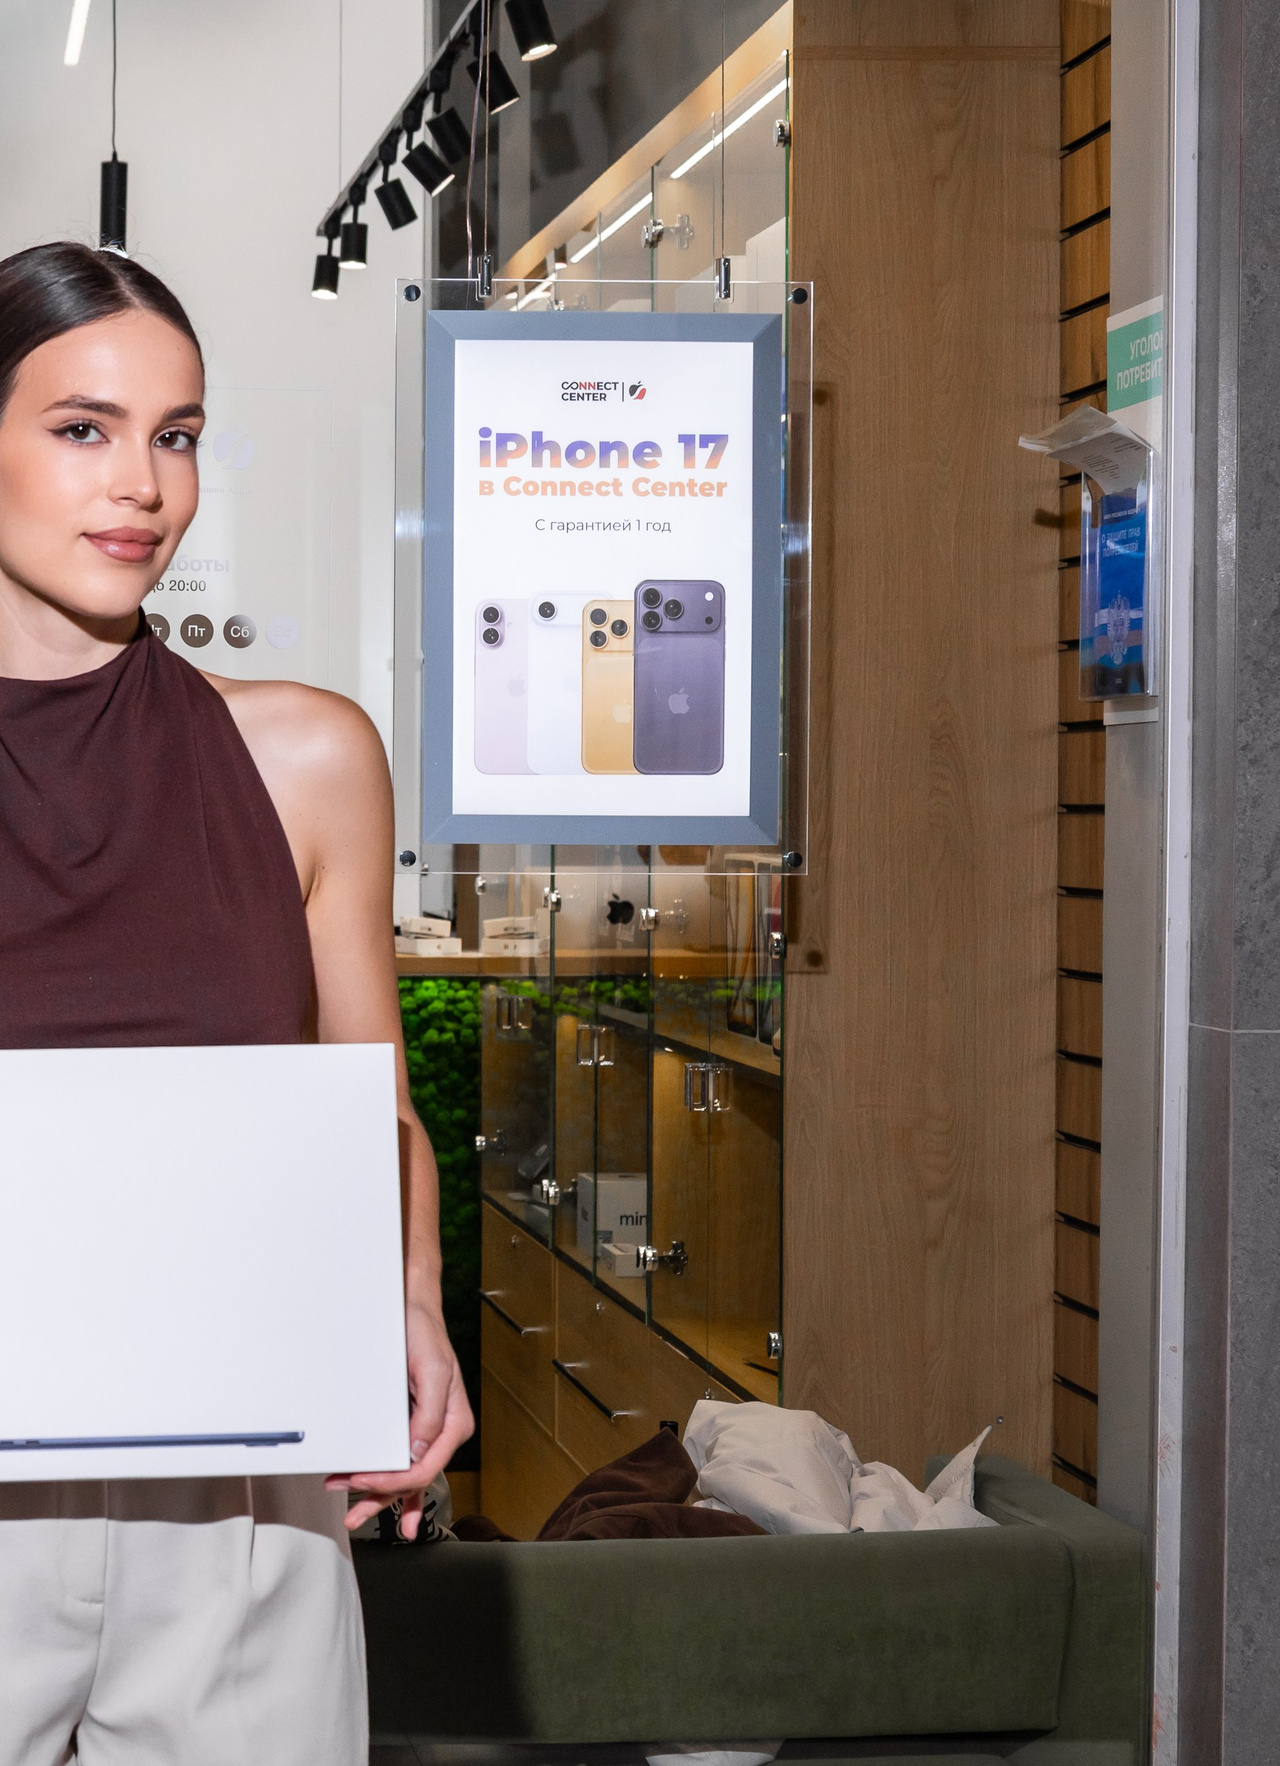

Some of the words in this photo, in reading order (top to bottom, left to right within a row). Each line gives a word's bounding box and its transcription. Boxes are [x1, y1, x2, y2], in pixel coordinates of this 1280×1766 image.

[1116, 357, 1163, 392] ПОТРЕБИТ
[561, 381, 620, 392] CONNECT
[561, 392, 608, 402] CENTER
[478, 427, 663, 471] iPhone
[677, 433, 729, 471] 17
[503, 476, 623, 497] Connect
[631, 476, 728, 498] Center
[534, 518, 546, 532] С
[550, 518, 632, 534] гарантией
[636, 519, 642, 531] 1
[646, 521, 672, 534] год
[167, 554, 230, 573] аботы
[168, 579, 207, 592] 20:00
[187, 624, 206, 637] Пт
[230, 625, 250, 638] Сб
[619, 1211, 648, 1226] min
